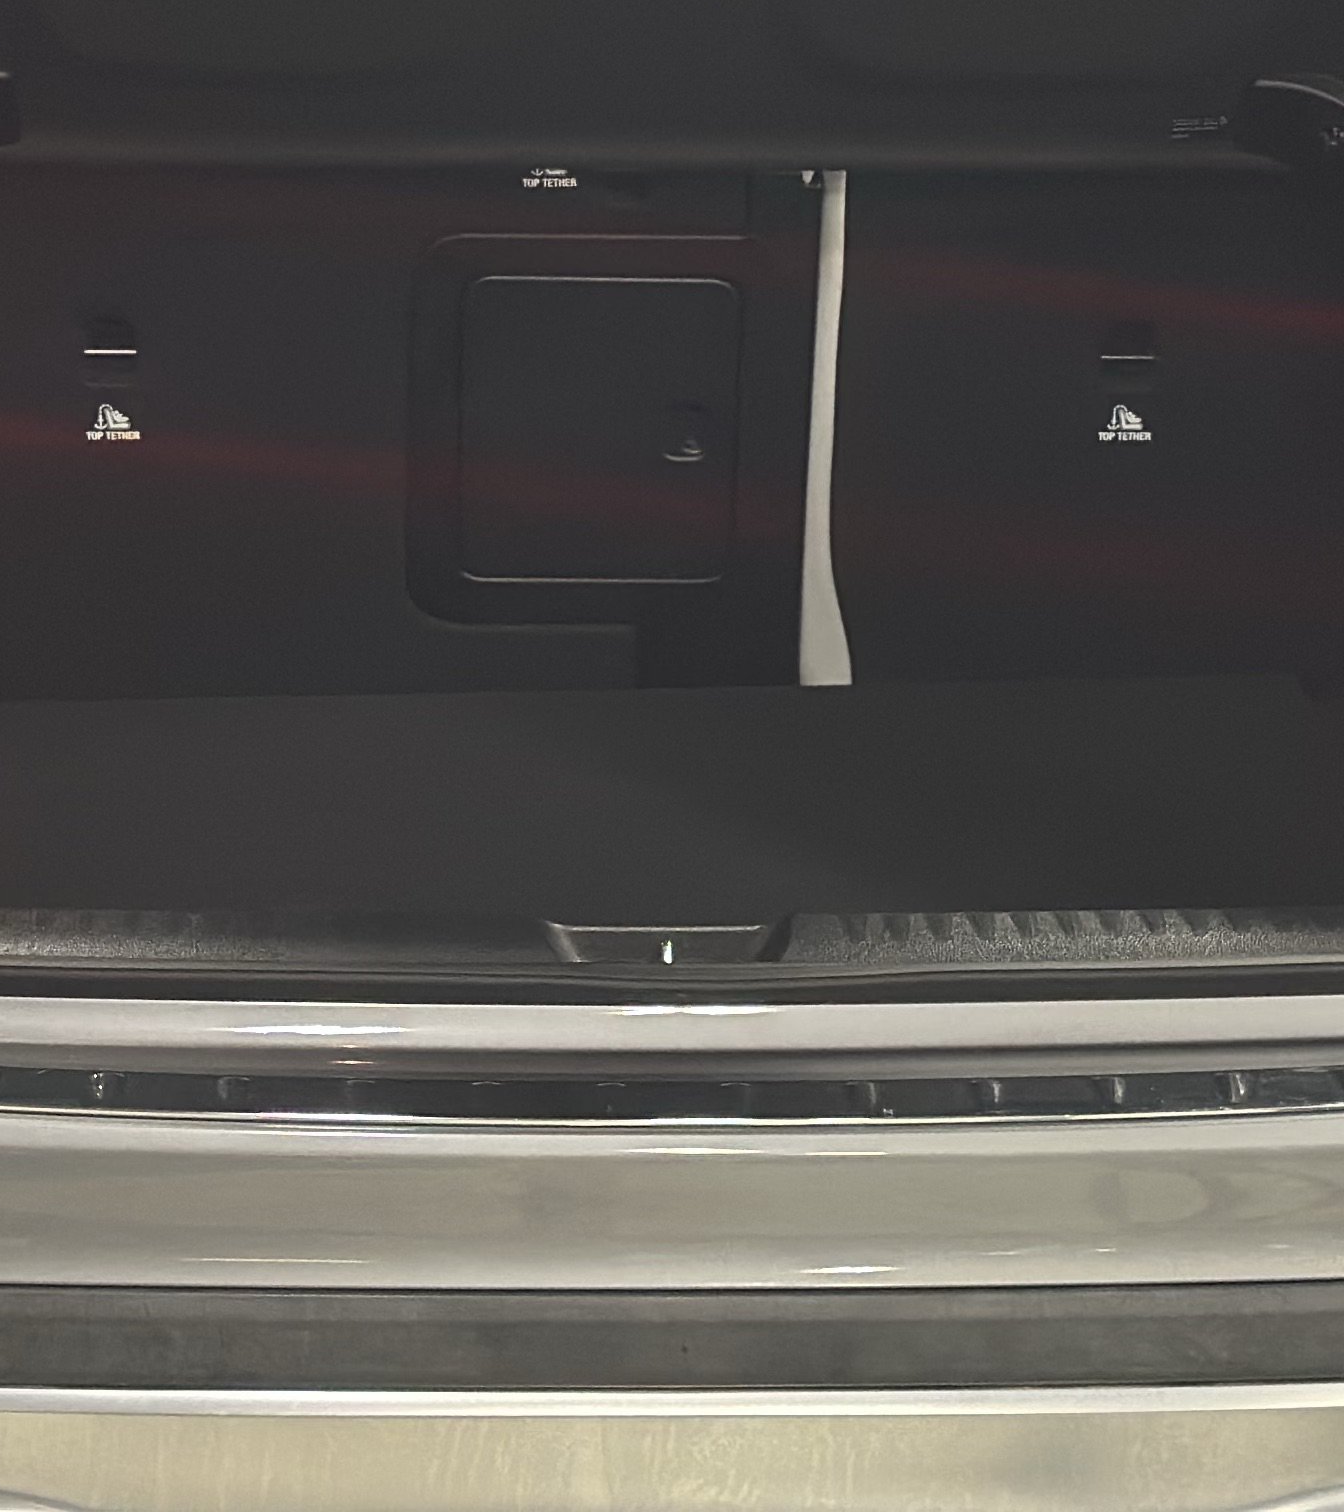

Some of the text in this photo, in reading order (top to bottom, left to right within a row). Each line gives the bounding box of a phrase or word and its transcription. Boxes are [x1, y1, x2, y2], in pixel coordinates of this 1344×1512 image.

[522, 177, 577, 188] TOP TETHER
[85, 431, 141, 441] TOP TETHER
[1098, 431, 1152, 441] TOP TETHER
